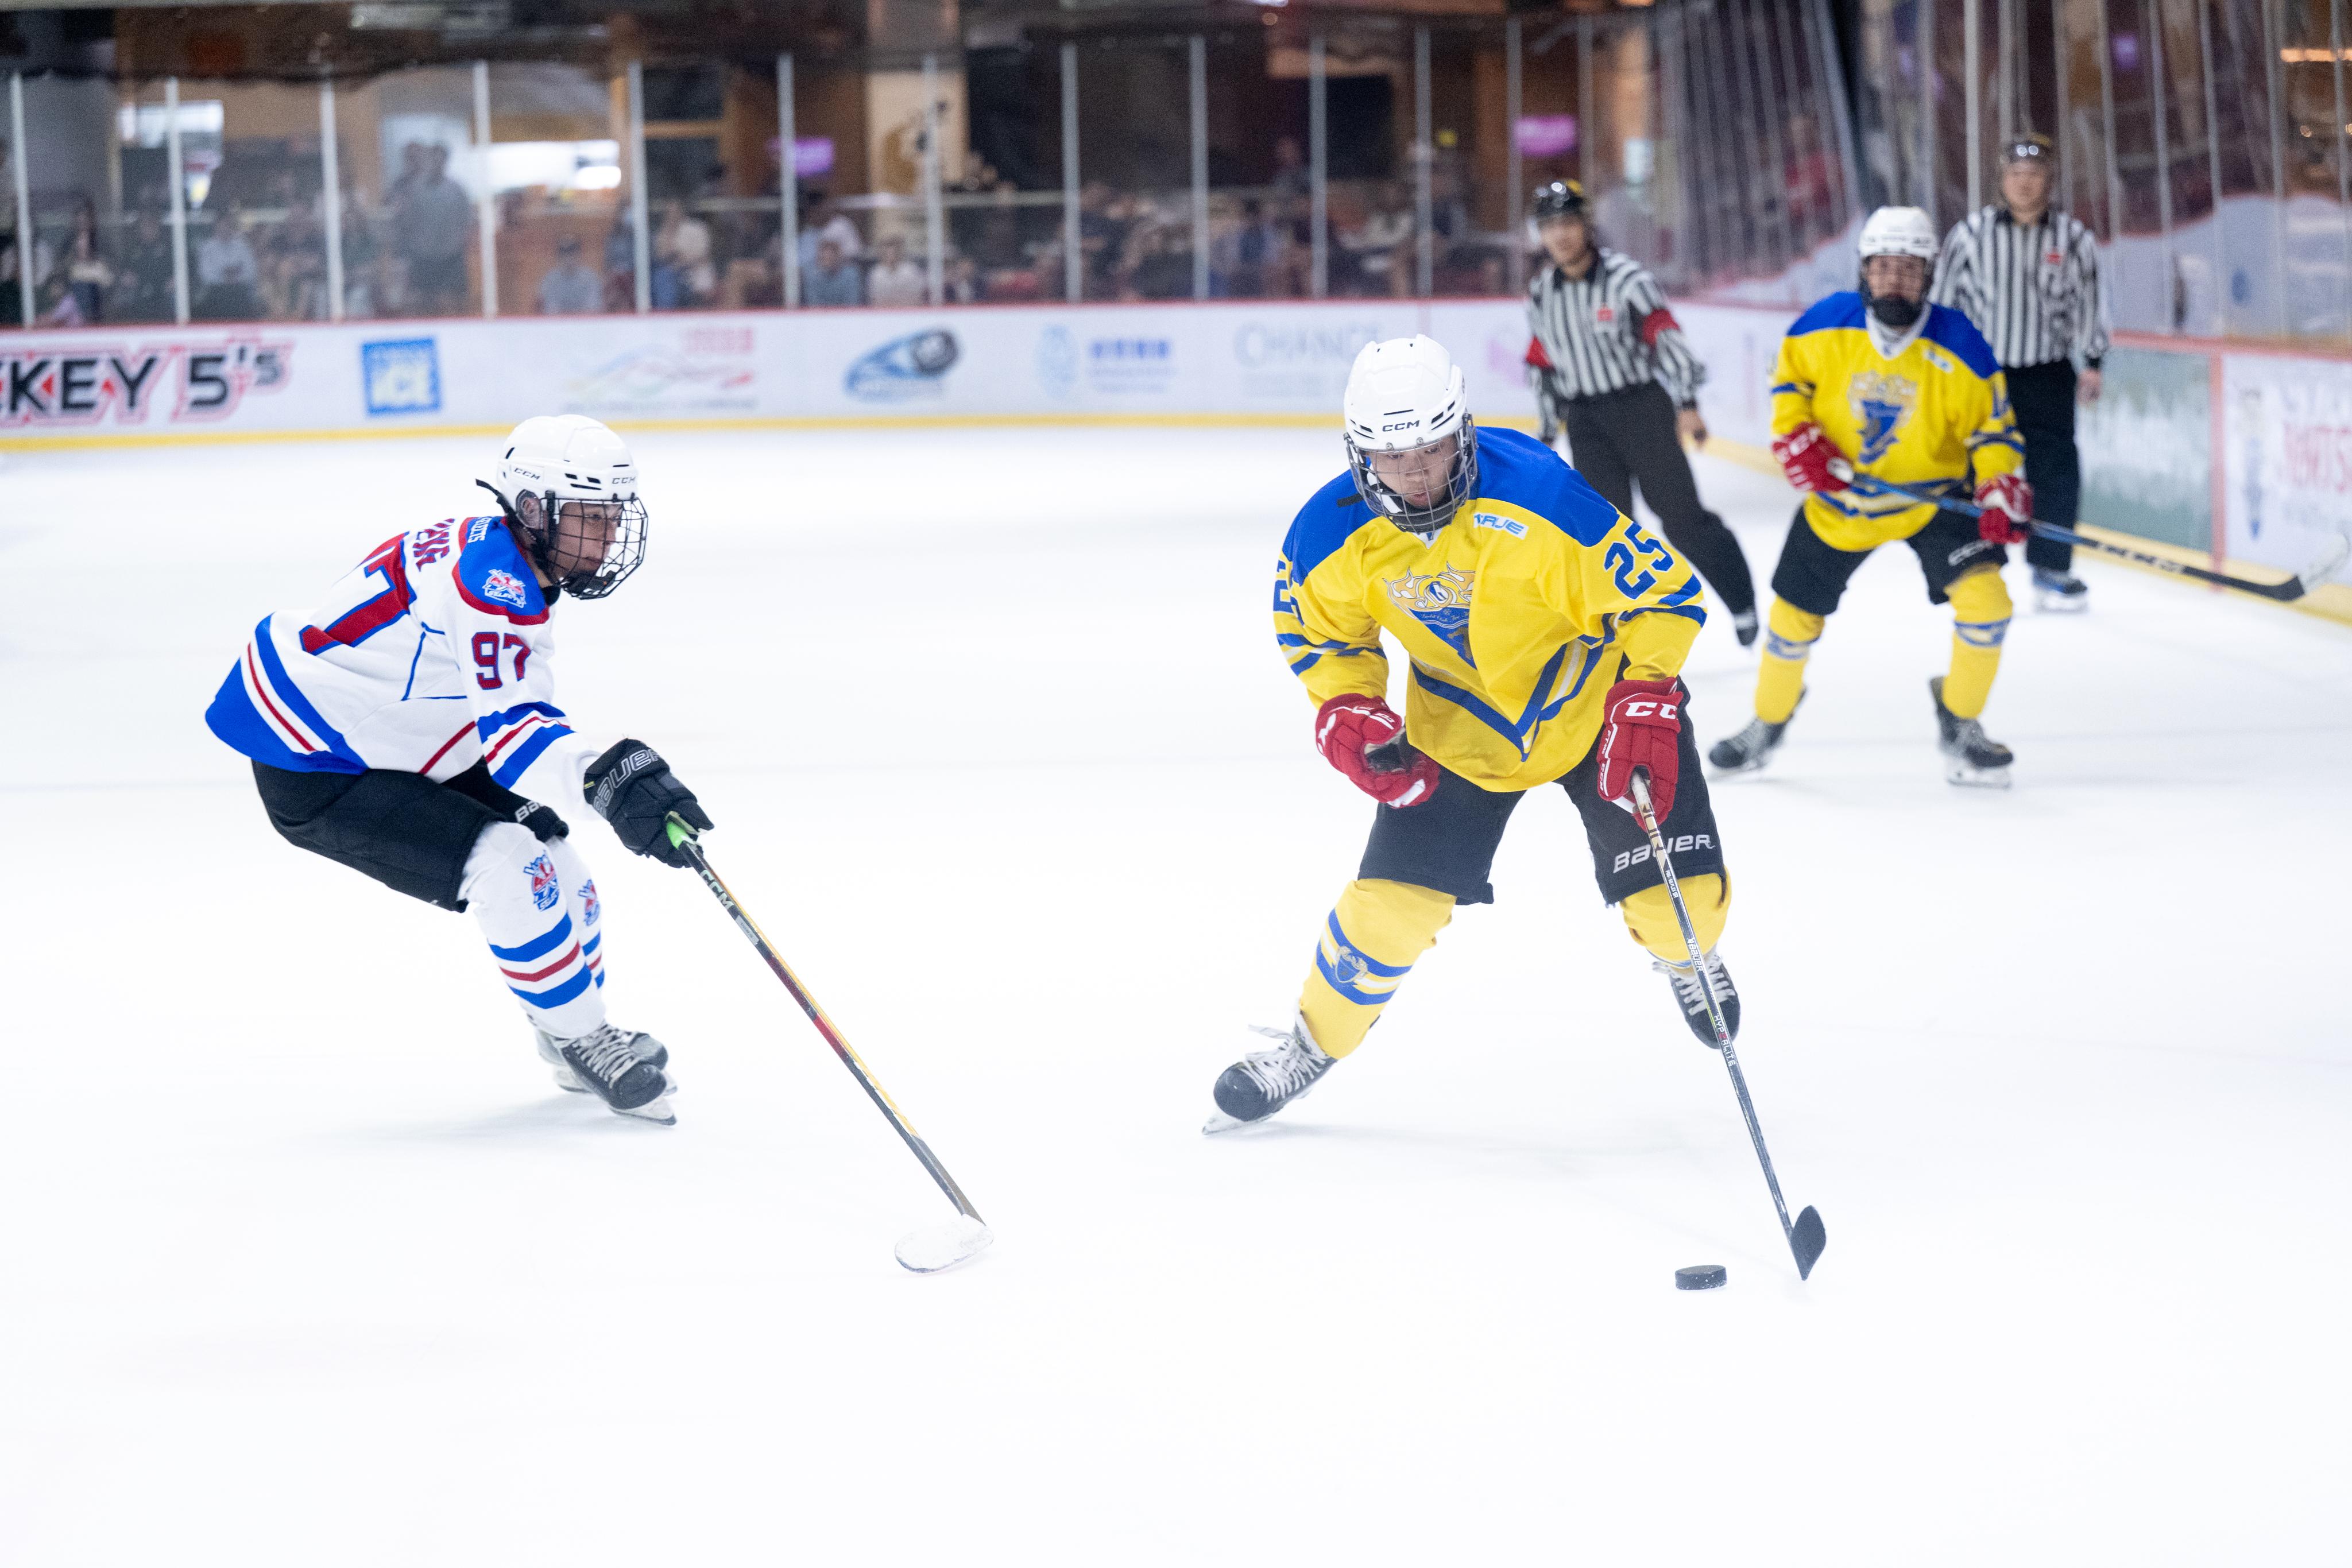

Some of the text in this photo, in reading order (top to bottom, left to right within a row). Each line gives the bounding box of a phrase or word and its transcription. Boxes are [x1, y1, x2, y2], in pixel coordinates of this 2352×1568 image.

[0, 354, 159, 415] KEY
[1382, 420, 1420, 432] CCM
[514, 467, 540, 480] CCM
[612, 477, 636, 485] CCM
[1604, 521, 1675, 600] 25
[298, 529, 418, 656] 7
[471, 632, 531, 690] 97
[1625, 702, 1678, 721] CC
[700, 869, 734, 910] CCM
[1713, 1015, 1736, 1066] HYPERLITE
